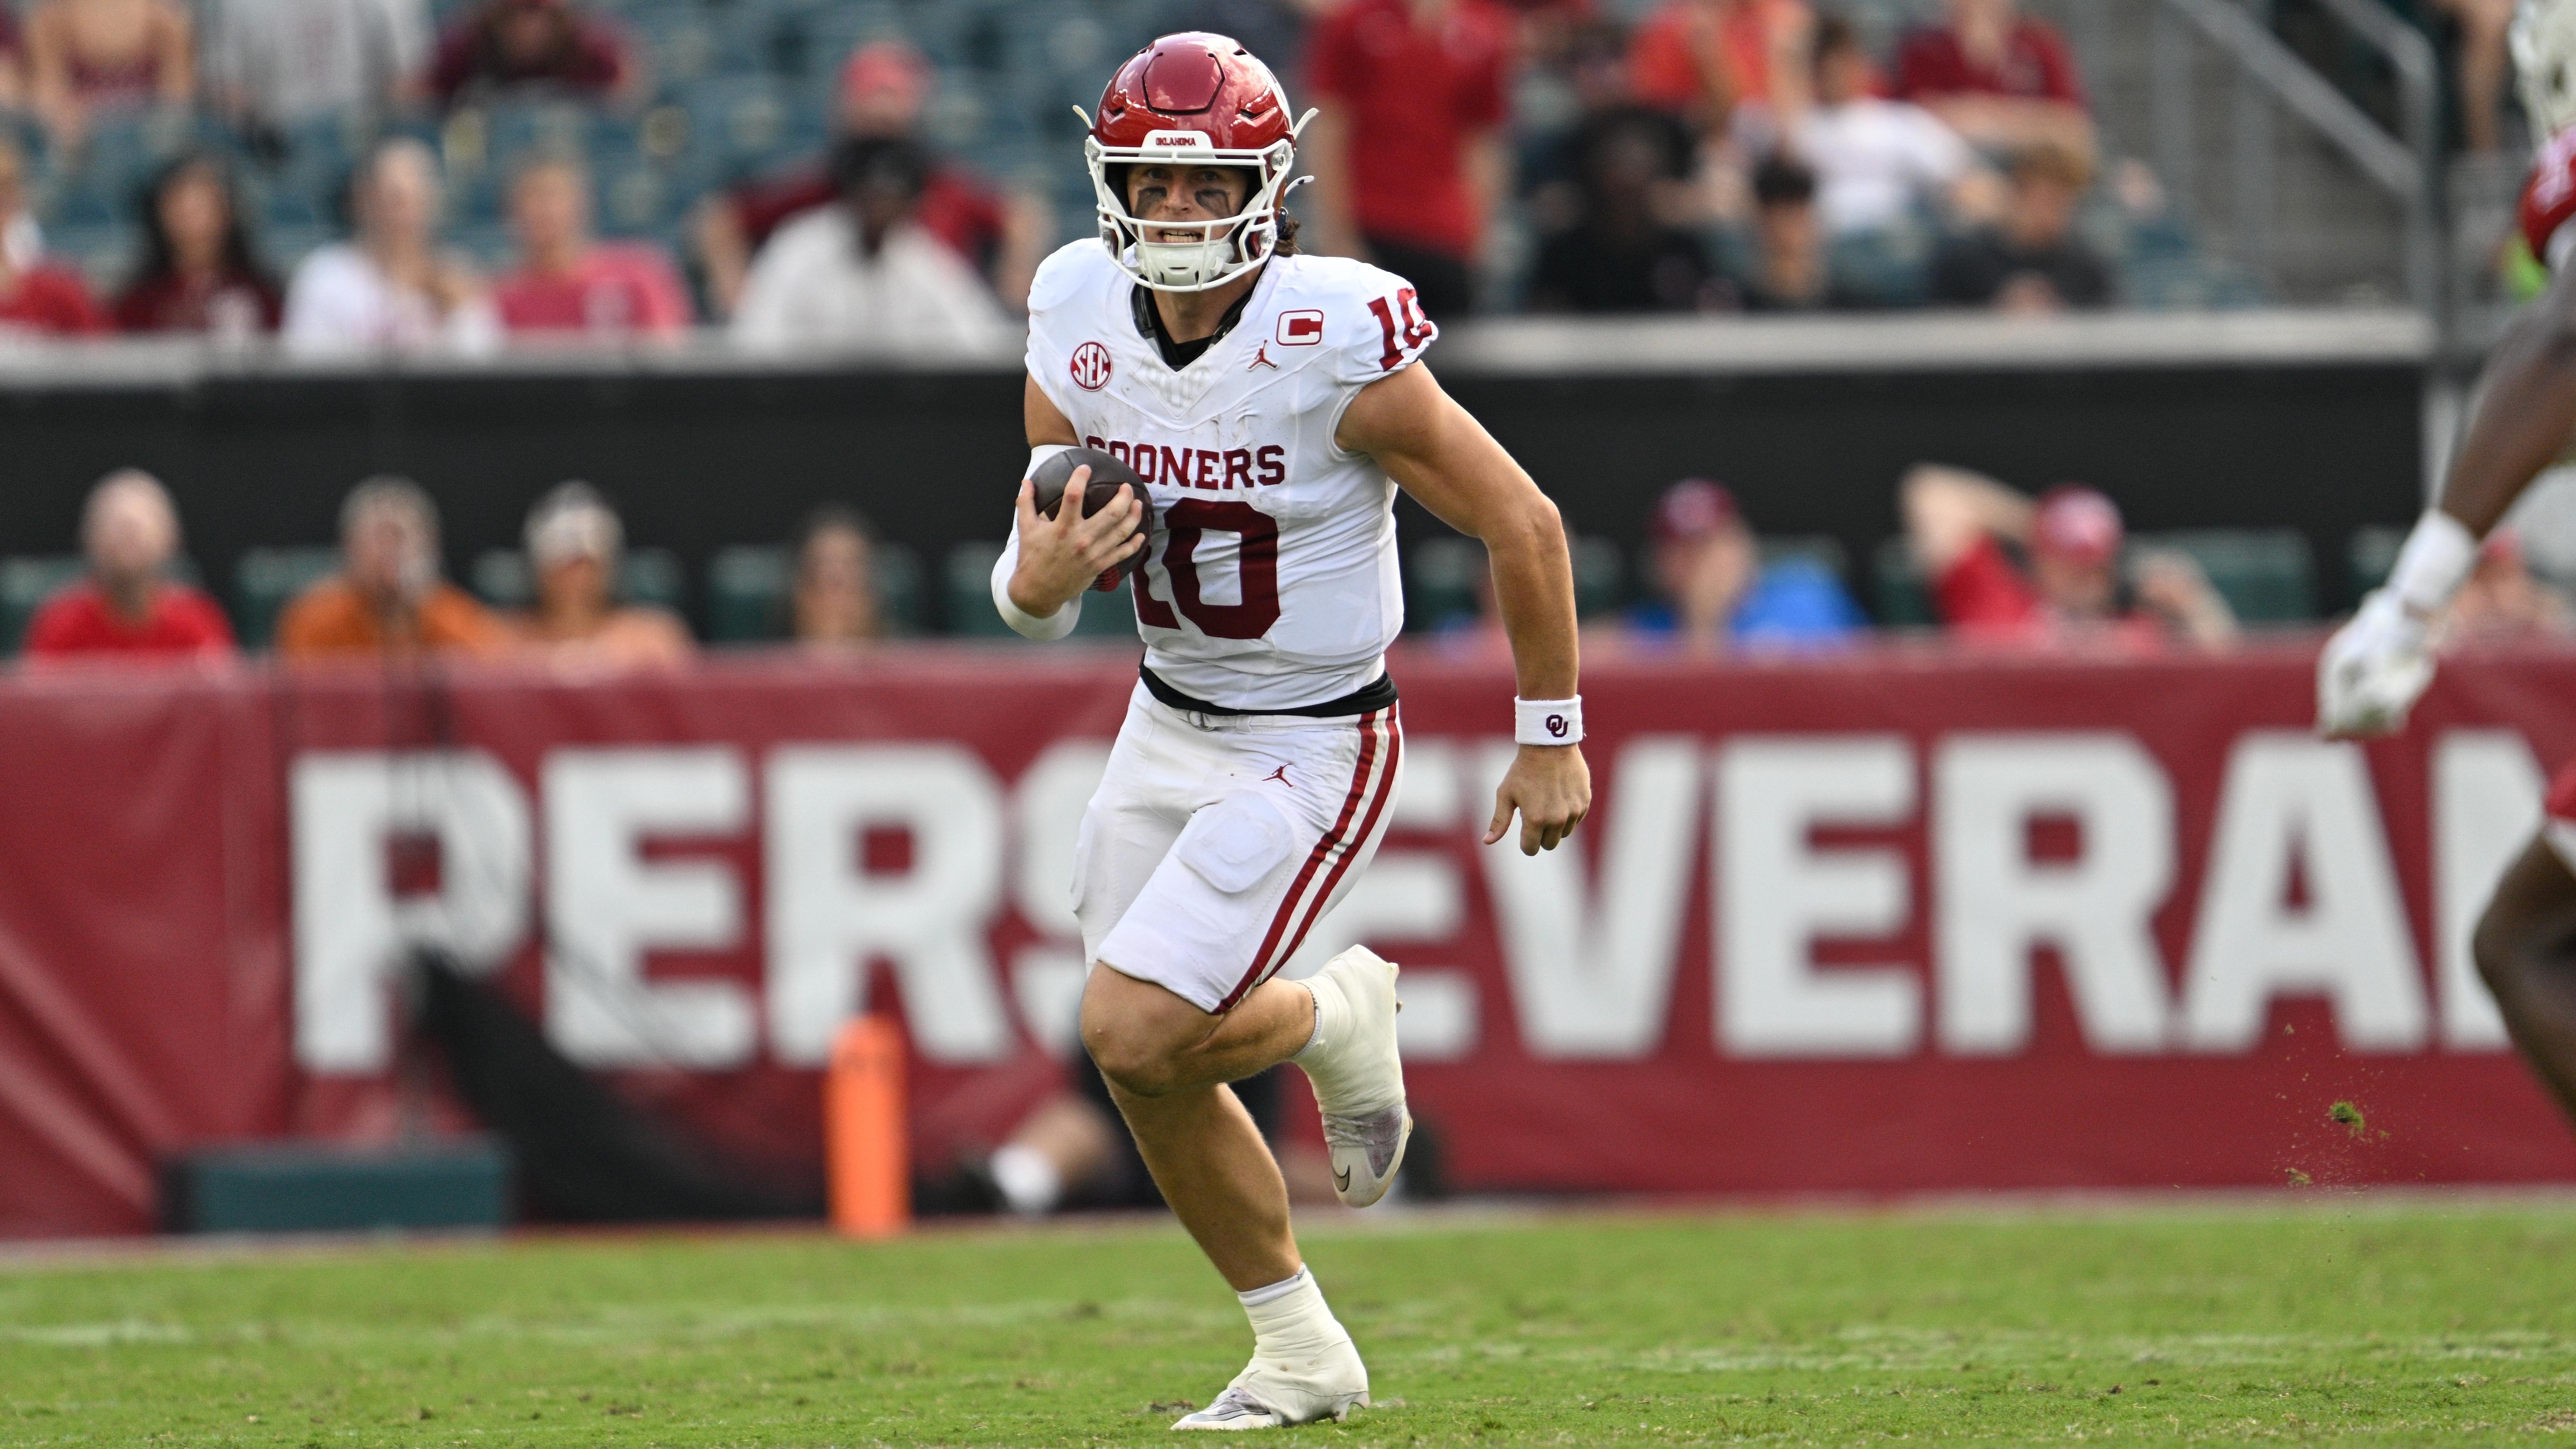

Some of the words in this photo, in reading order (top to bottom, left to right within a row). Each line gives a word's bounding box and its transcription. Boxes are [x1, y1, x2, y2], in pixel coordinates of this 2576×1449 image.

[1155, 137, 1196, 146] OKLAHOMA
[1367, 287, 1432, 372] 10
[1073, 343, 1109, 388] SEC
[1131, 497, 1281, 640] 10
[1546, 714, 1569, 738] OU
